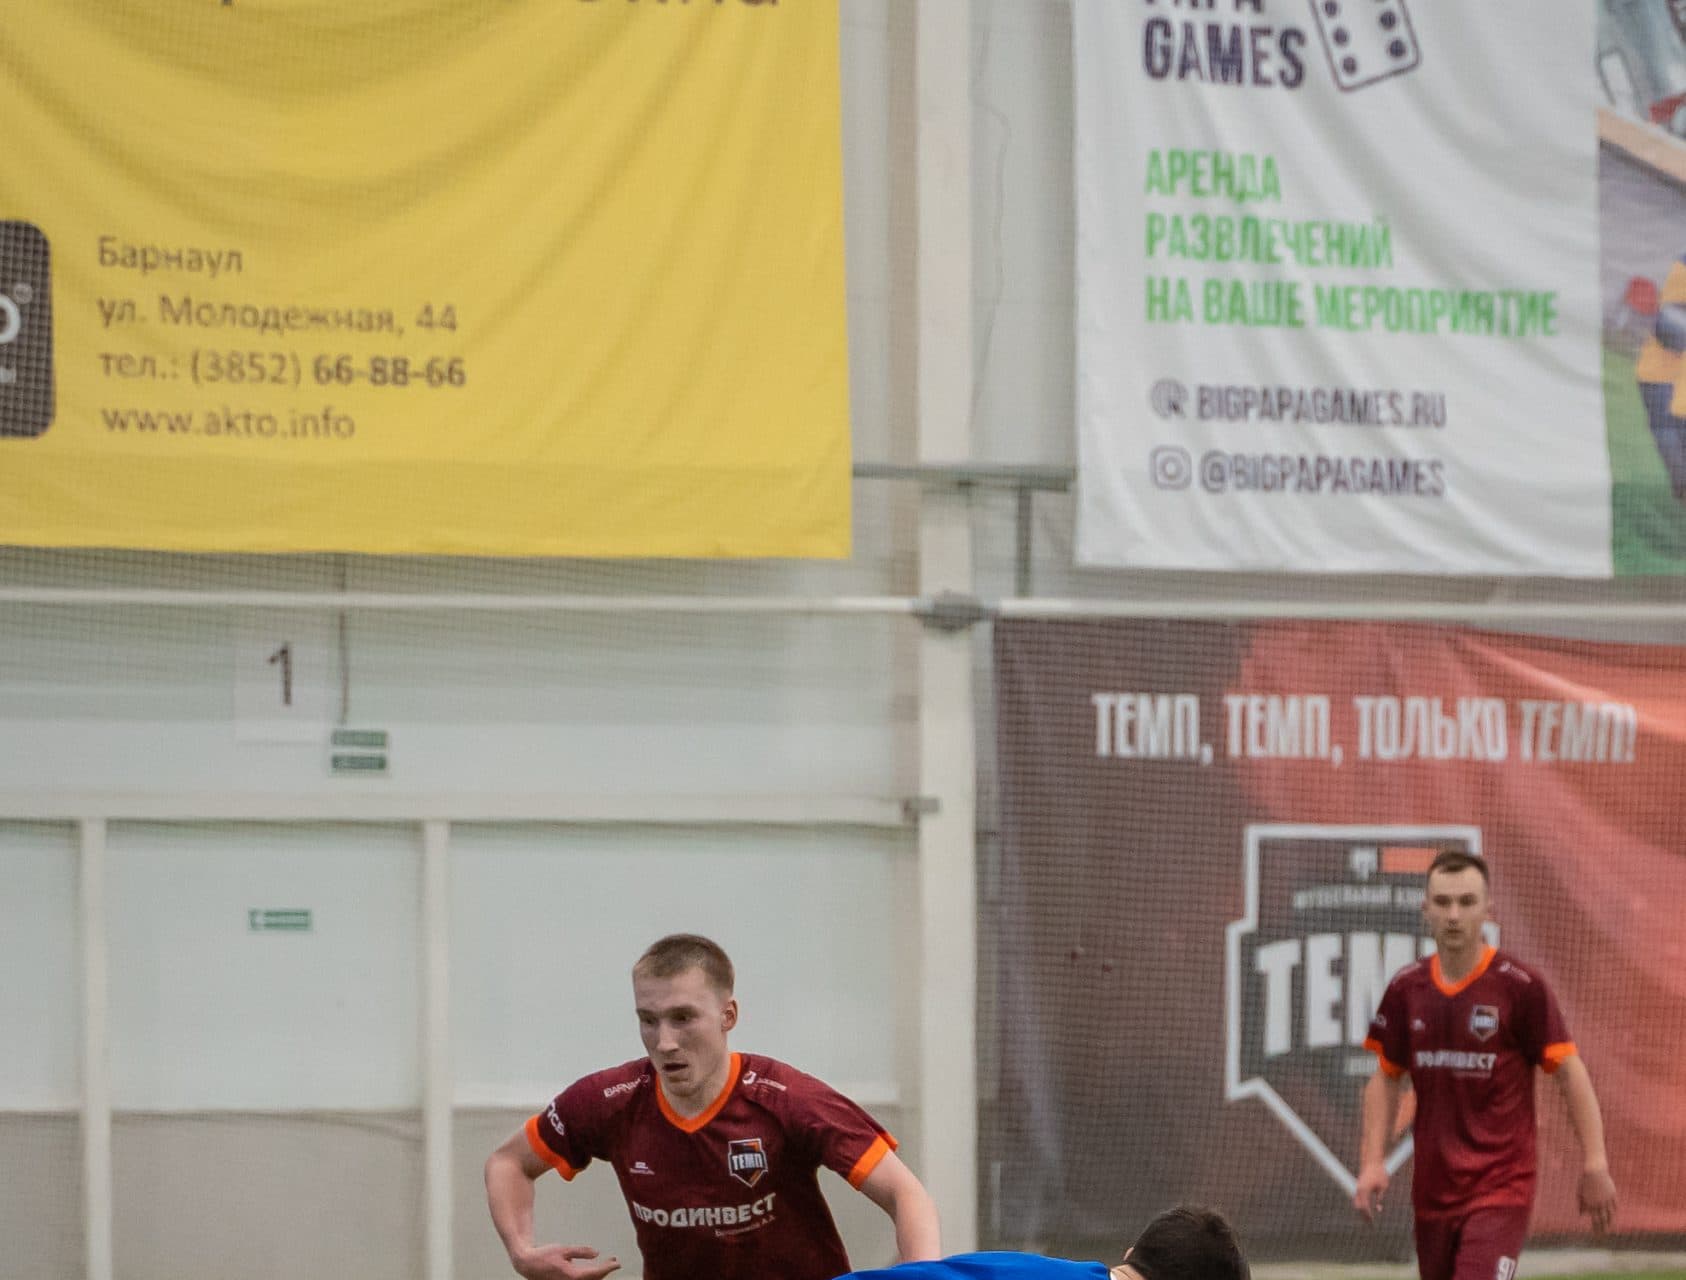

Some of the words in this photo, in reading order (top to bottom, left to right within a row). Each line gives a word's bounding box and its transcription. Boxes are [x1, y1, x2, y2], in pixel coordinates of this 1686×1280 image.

[1143, 18, 1306, 89] GAMES
[1145, 148, 1282, 204] АРЕНДА
[98, 235, 244, 279] Барнаул
[1146, 211, 1394, 268] РАЗВЛЕЧЕНИЙ
[97, 297, 147, 328] ул.
[160, 293, 405, 338] Молодежная,
[416, 302, 457, 333] 44
[1146, 273, 1194, 323] НА
[1203, 276, 1305, 328] ВАШЕ
[1313, 283, 1559, 338] МЕРОПРИЯТИЕ
[99, 352, 179, 381] тел.:
[191, 350, 302, 388] (3852)
[313, 353, 467, 389] 66-88-66
[101, 404, 355, 438] www.akto.info
[1196, 384, 1447, 427] BIGPAPAGAMES.RU
[1201, 449, 1446, 497] @BIGPAPAGAMES
[266, 641, 292, 706] 1
[1092, 693, 1214, 768] ТЕМП,
[1224, 693, 1343, 768] ТЕМП,
[1353, 695, 1508, 762] ТОЛЬКО
[1520, 698, 1638, 763] ТЕМП!
[632, 1192, 776, 1227] ПРОДИНВЕСТ
